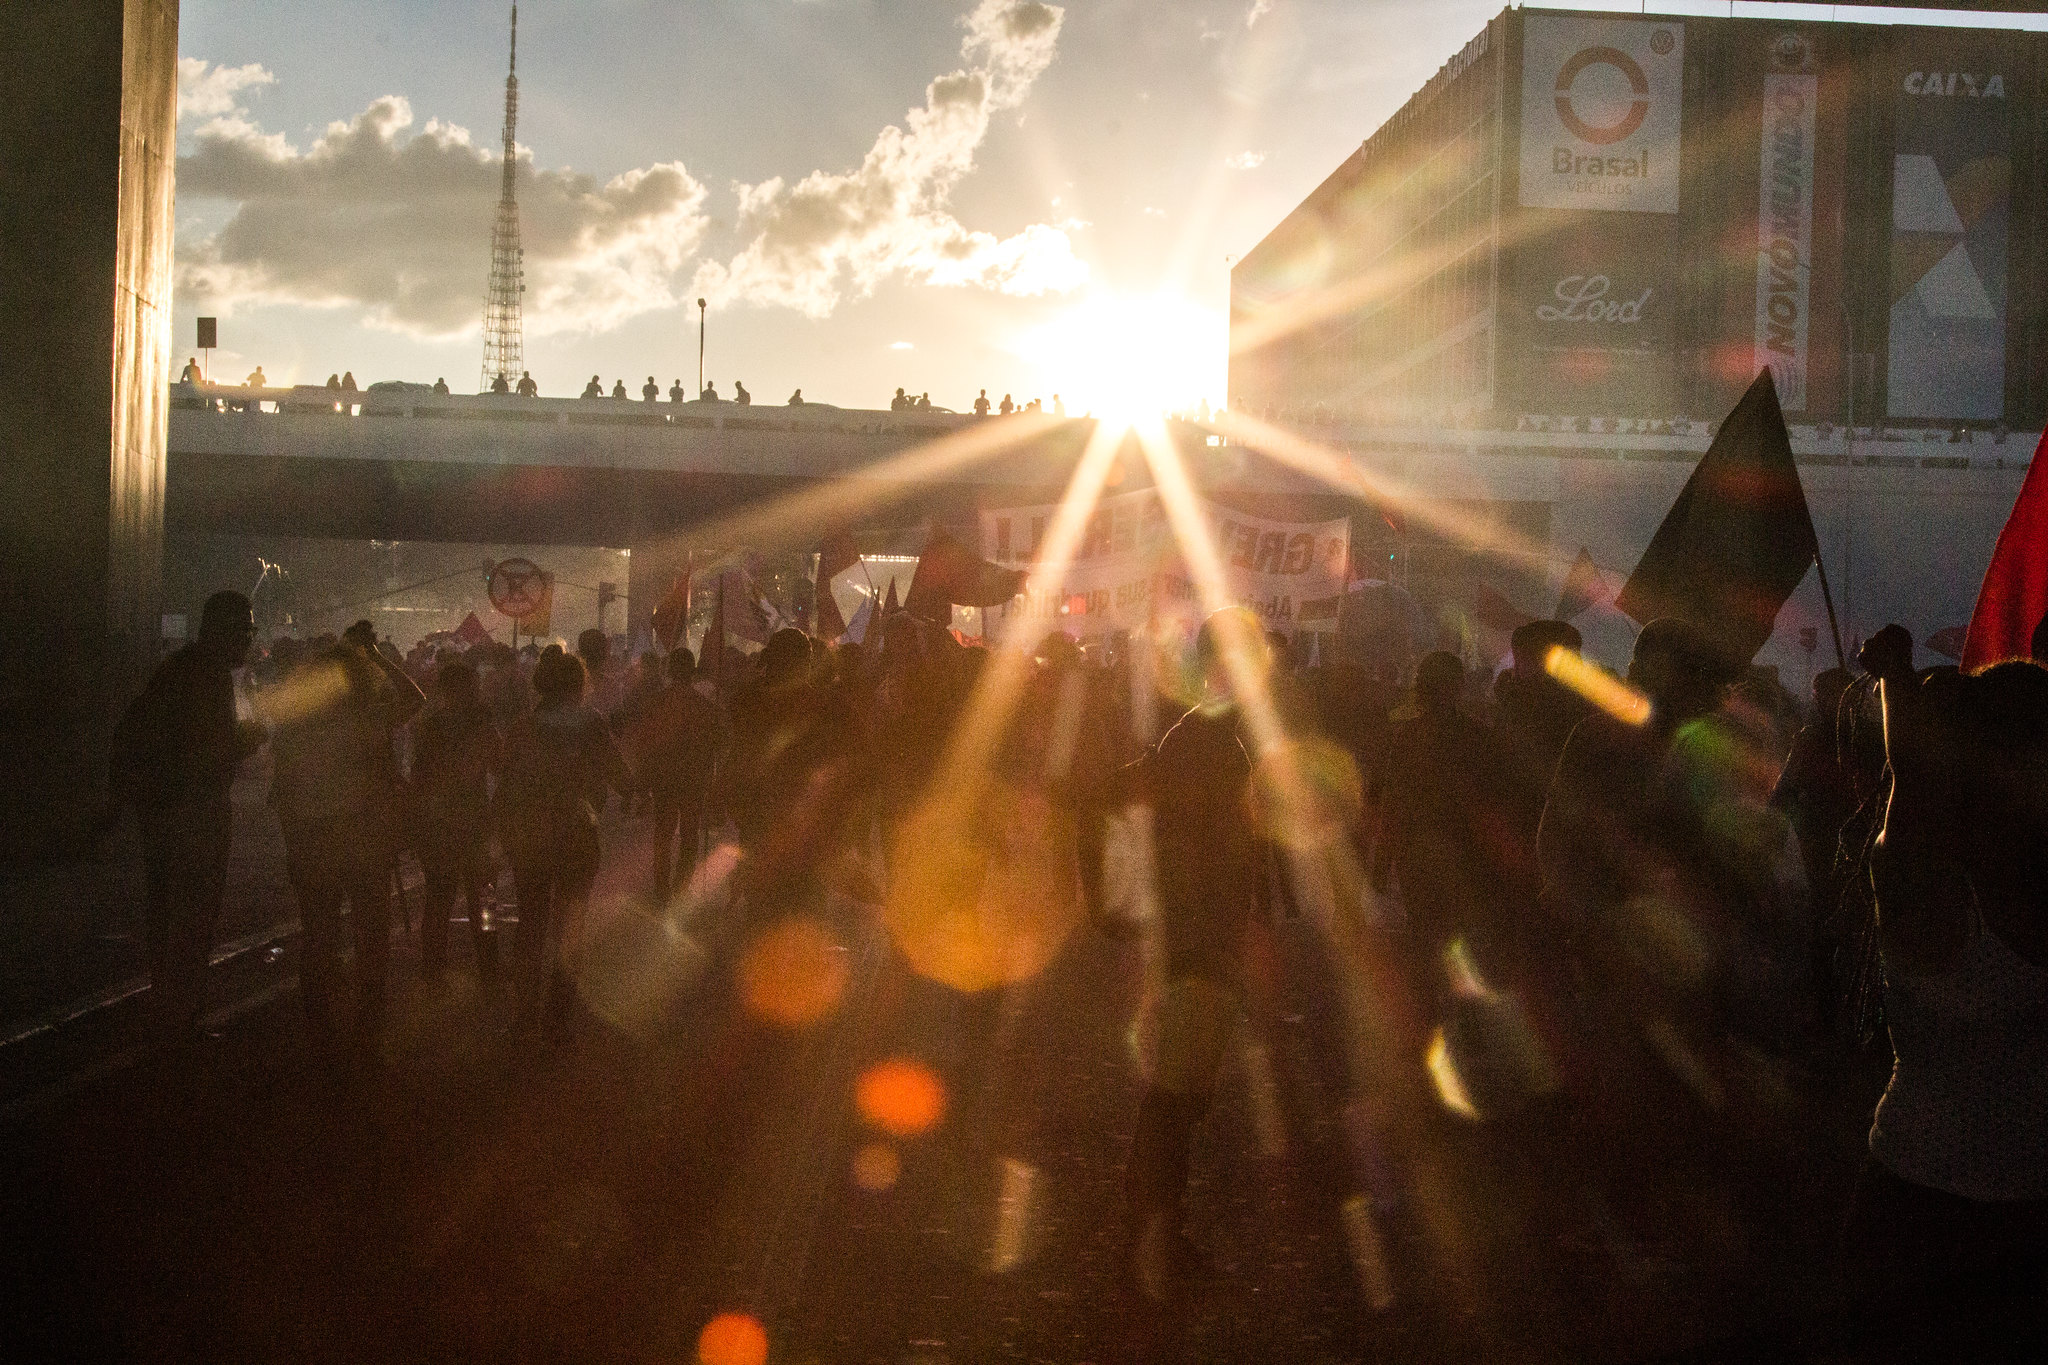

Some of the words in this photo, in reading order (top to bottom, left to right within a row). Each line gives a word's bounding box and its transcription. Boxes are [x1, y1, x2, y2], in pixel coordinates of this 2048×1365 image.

[1903, 70, 2005, 98] CAIXA
[1552, 146, 1648, 178] Brasal
[1535, 274, 1653, 323] Lord
